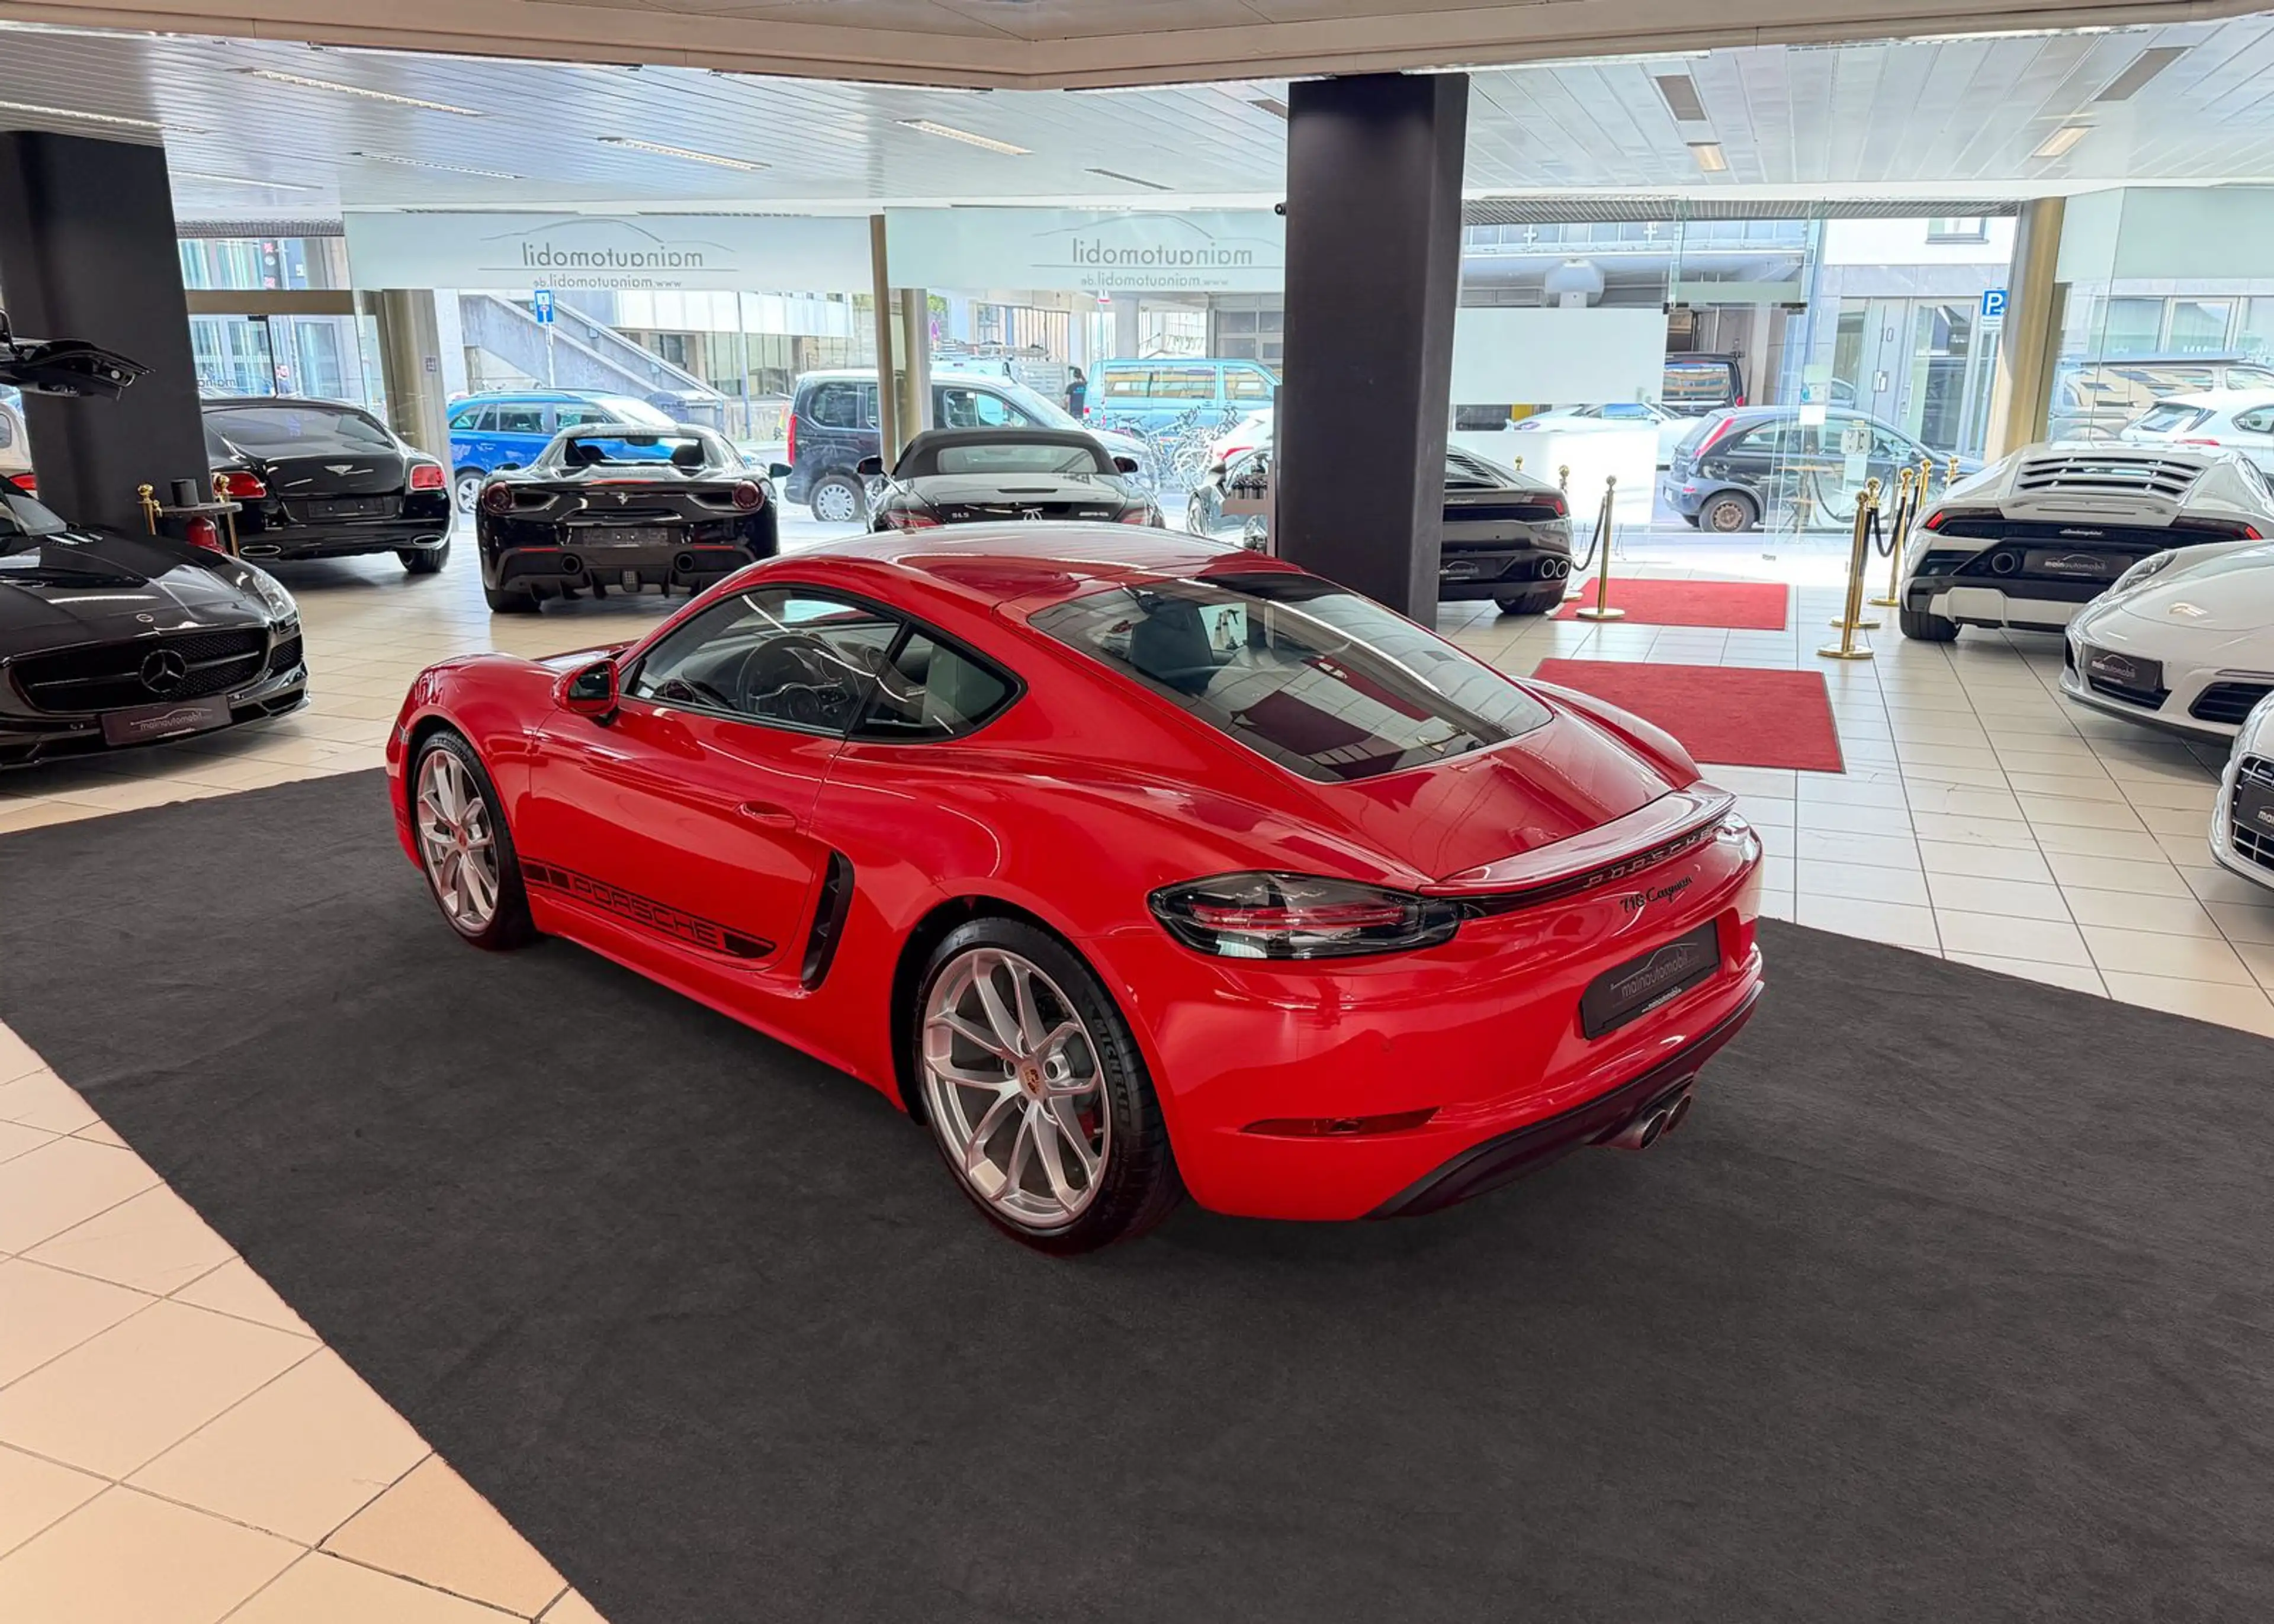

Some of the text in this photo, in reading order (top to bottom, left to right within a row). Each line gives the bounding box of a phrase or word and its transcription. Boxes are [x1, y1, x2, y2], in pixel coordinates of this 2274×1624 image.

[1986, 293, 2003, 315] P
[573, 876, 718, 944] PORSCHE
[1620, 895, 1646, 912] 718
